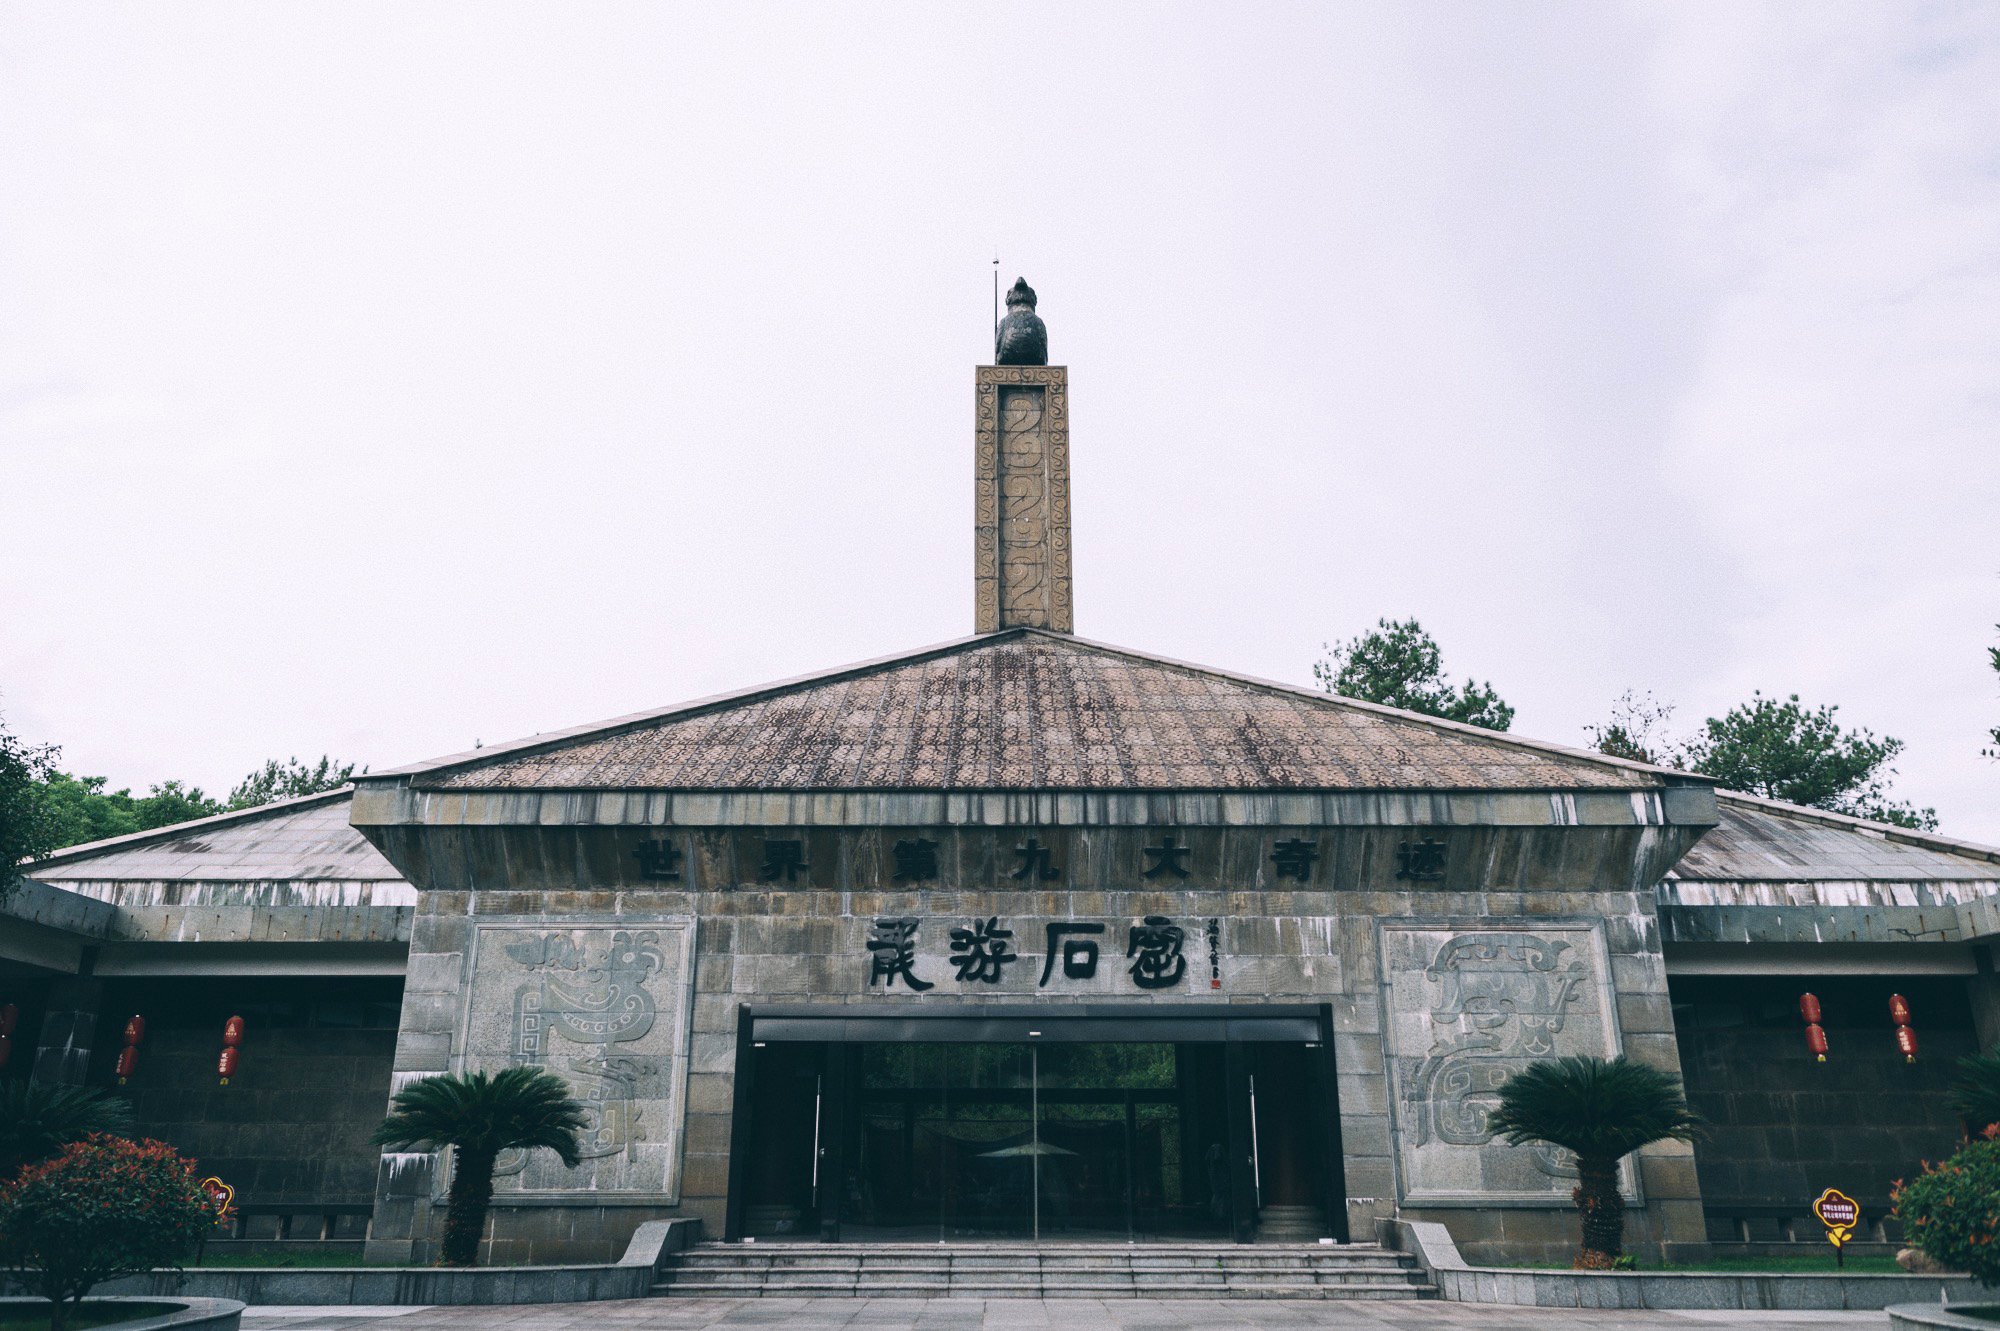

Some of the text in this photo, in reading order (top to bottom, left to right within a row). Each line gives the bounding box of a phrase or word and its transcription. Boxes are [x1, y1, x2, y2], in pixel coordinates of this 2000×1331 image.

[632, 837, 1447, 881] 世界第九大奇迹
